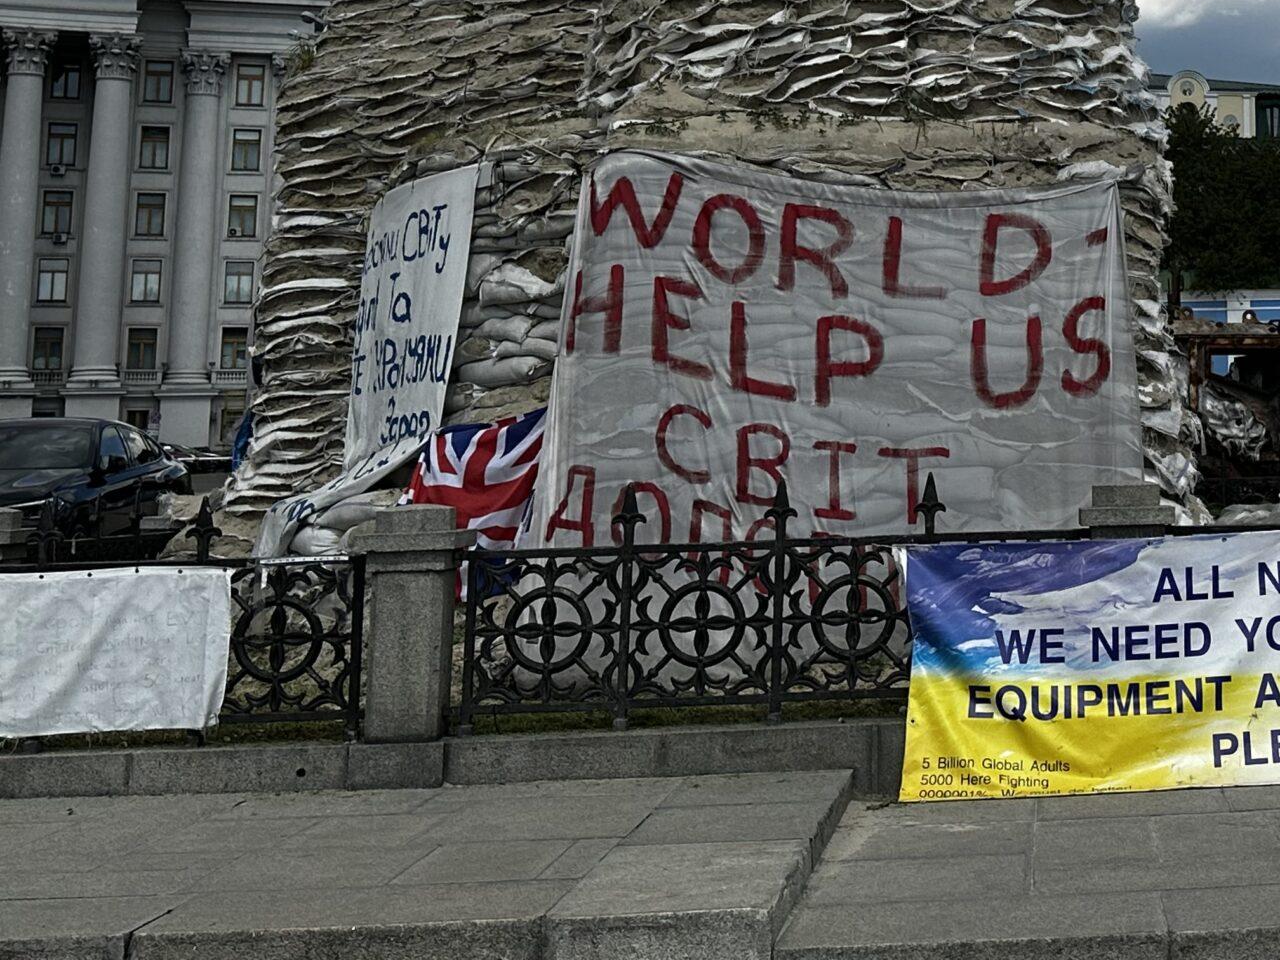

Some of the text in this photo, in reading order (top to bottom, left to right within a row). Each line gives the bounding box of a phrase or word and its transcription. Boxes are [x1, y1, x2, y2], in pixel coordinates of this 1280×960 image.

[566, 264, 886, 408] HELP
[970, 296, 1112, 410] US
[1152, 565, 1234, 603] ALL
[994, 628, 1065, 664] WE
[1092, 621, 1212, 662] NEED
[967, 675, 1232, 723] EQUIPMENT
[920, 773, 1049, 789] 5000 Here Fighting
[922, 757, 1071, 772] 5 Billion Global Adults
